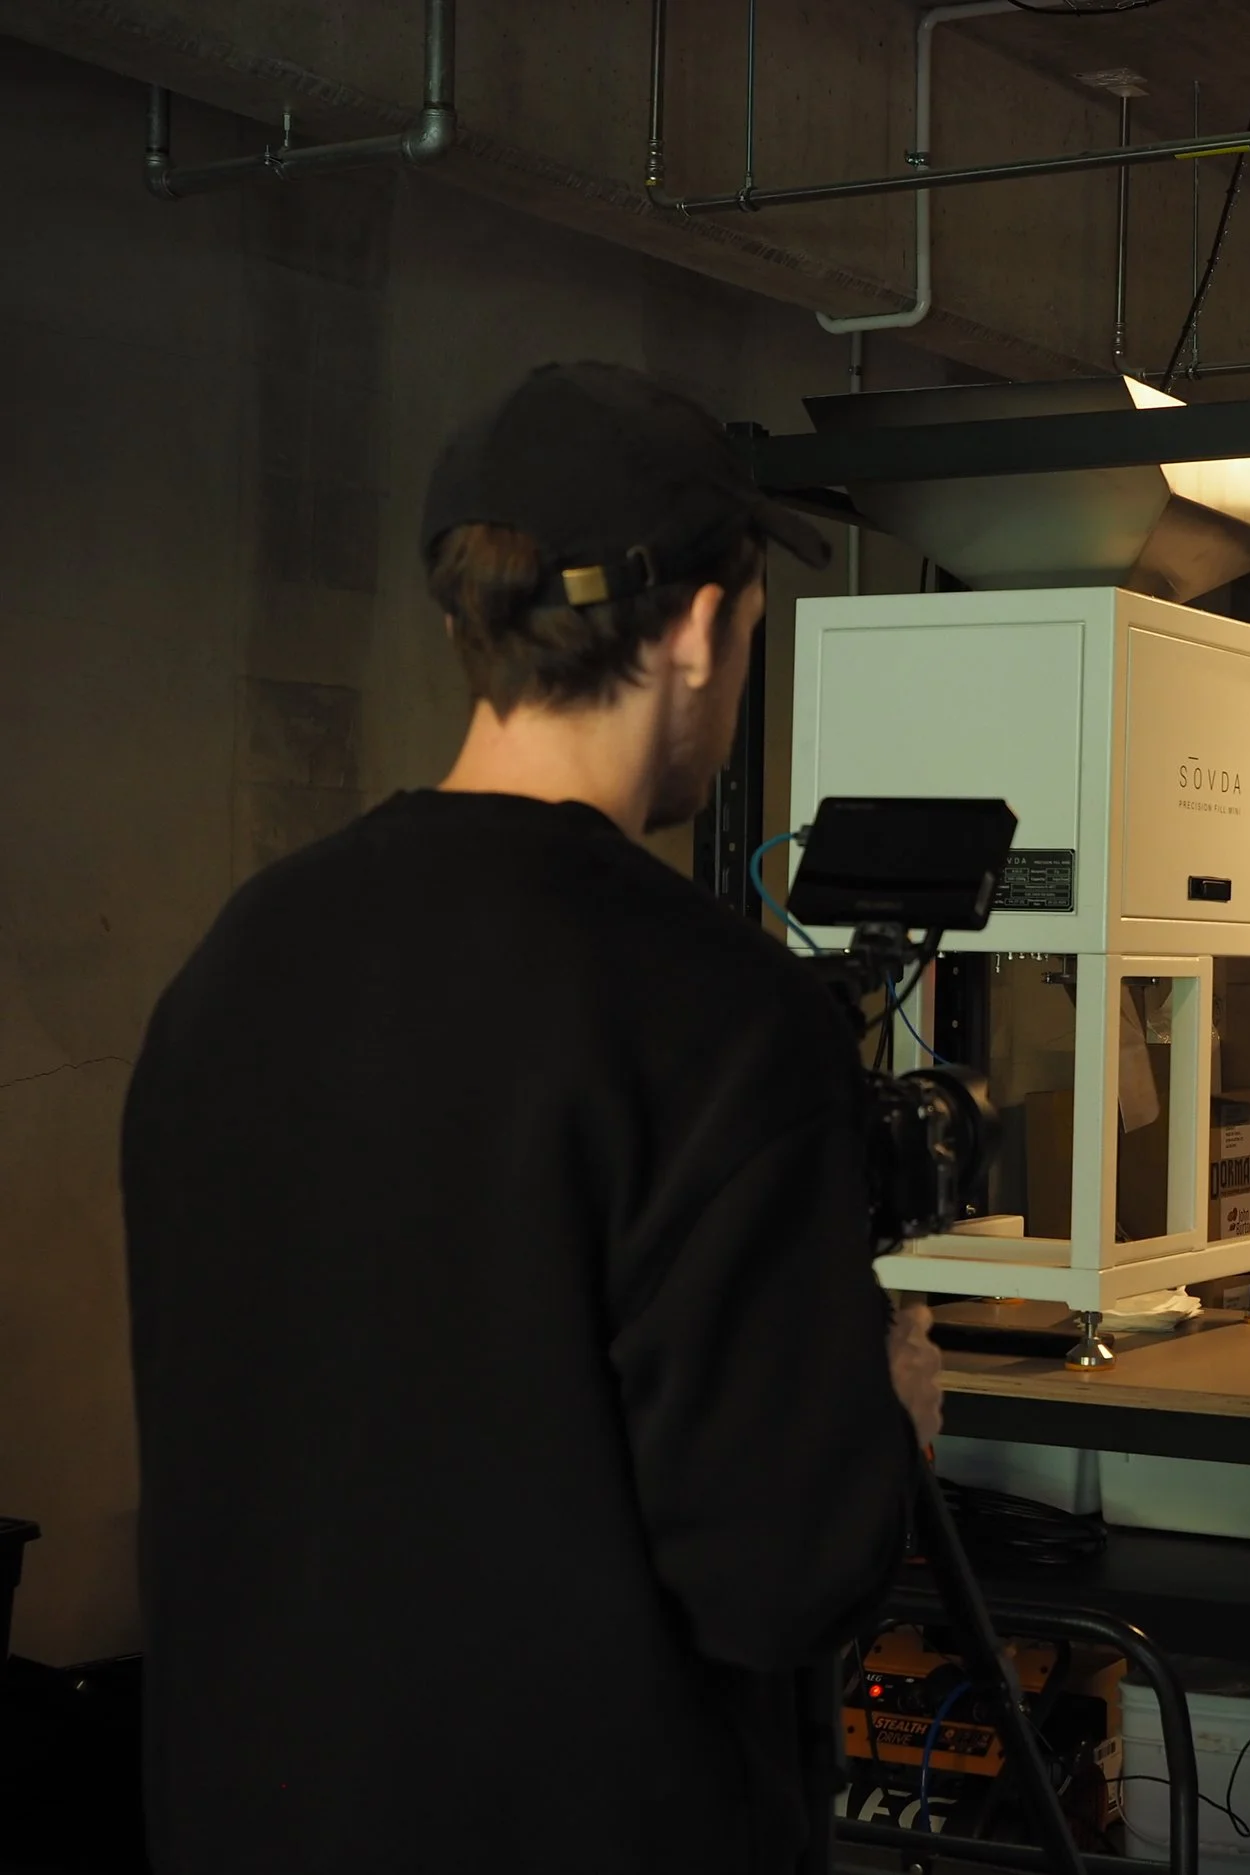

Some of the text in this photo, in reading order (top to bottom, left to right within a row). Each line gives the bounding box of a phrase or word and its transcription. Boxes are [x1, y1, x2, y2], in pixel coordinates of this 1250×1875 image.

[1178, 800, 1212, 812] PRECISION
[1214, 804, 1226, 814] FILL
[1006, 857, 1027, 865] VDA
[875, 1718, 928, 1735] STEALTH
[877, 1731, 913, 1745] DRIVE
